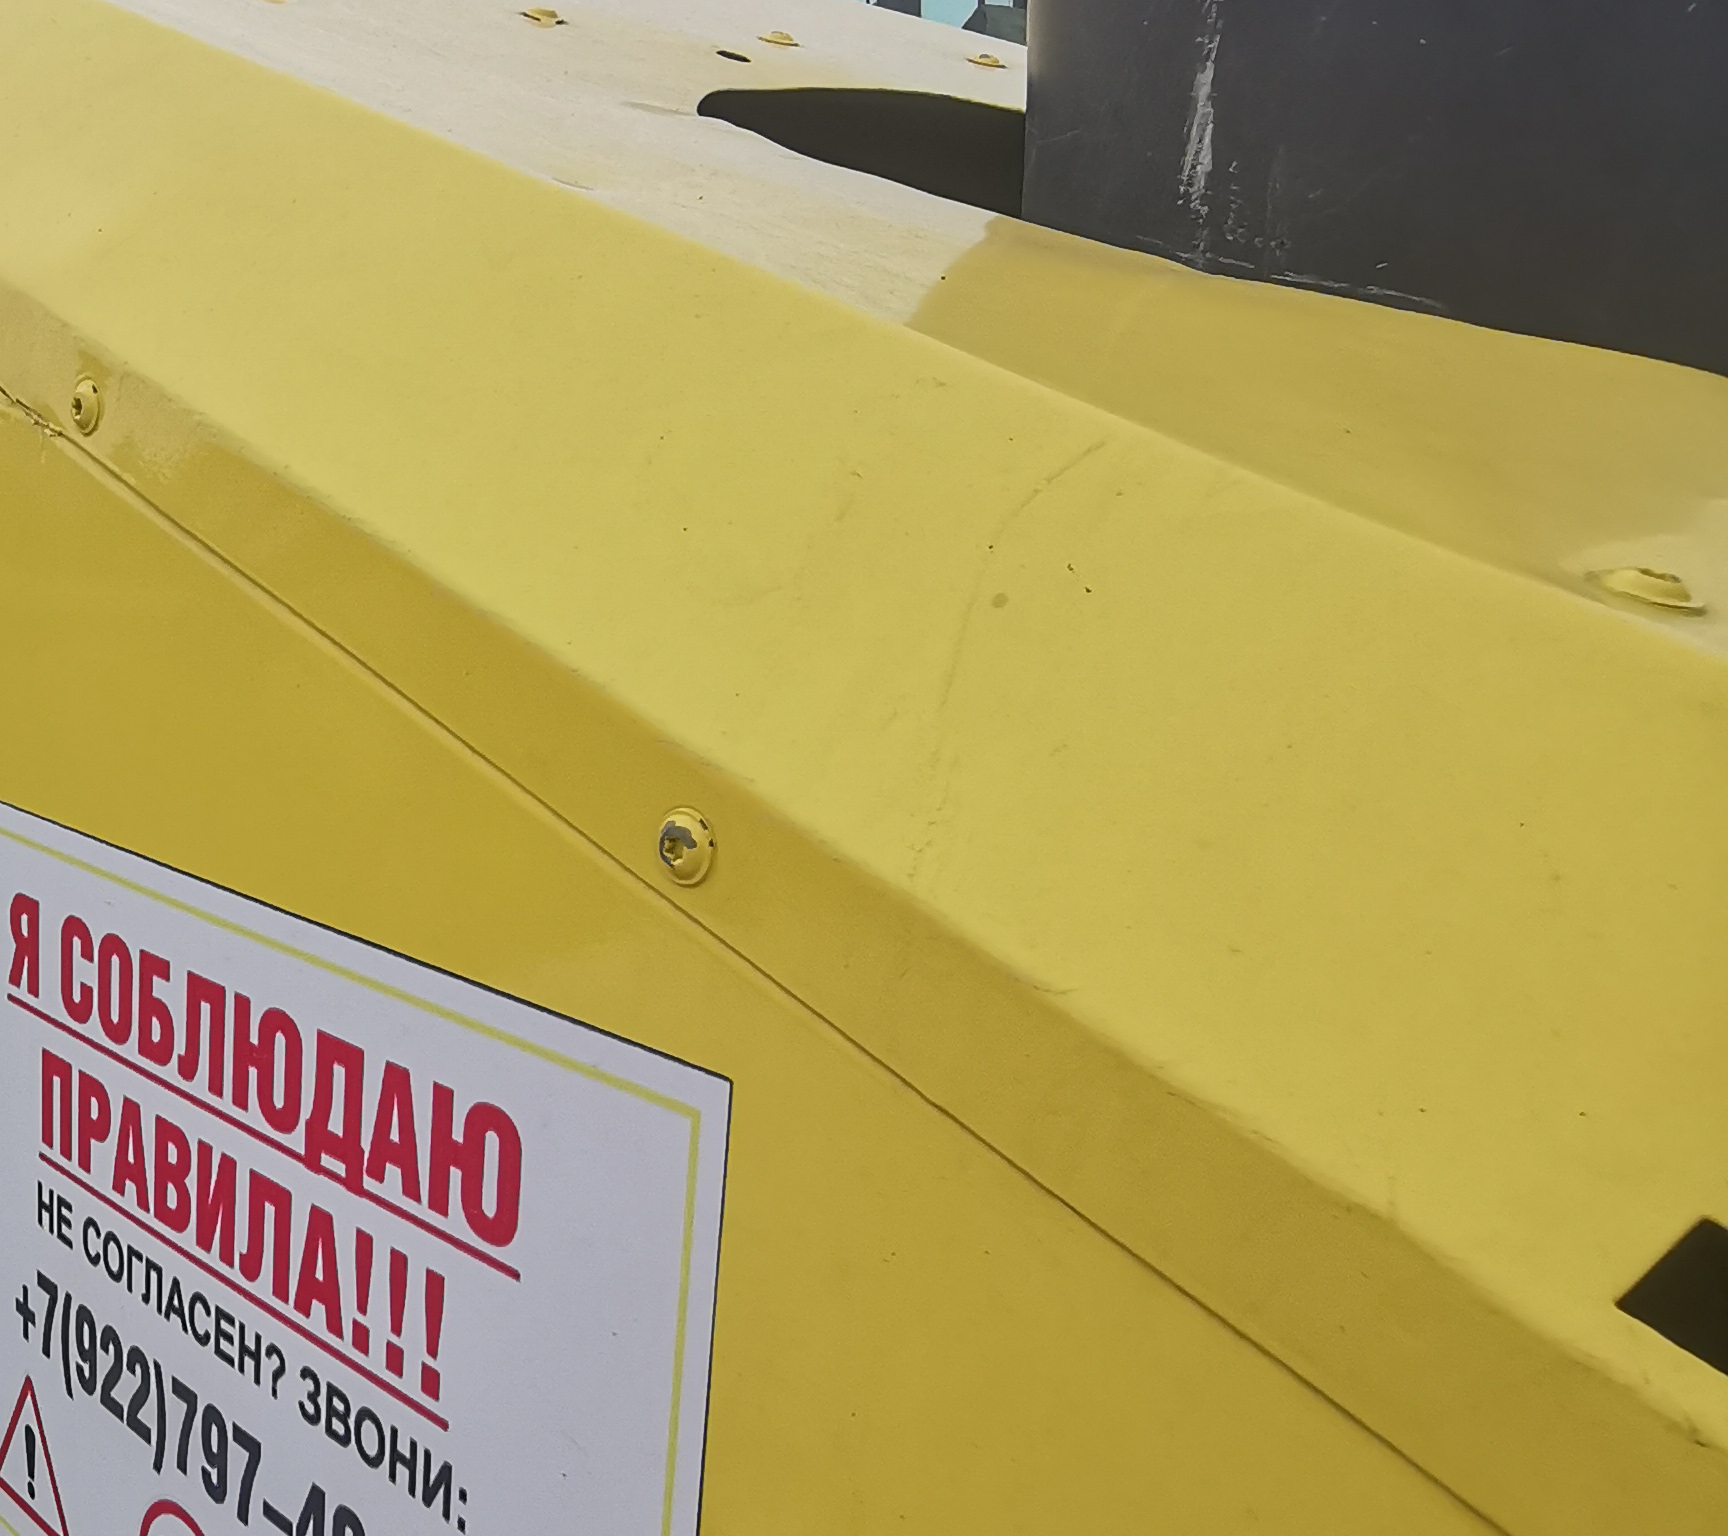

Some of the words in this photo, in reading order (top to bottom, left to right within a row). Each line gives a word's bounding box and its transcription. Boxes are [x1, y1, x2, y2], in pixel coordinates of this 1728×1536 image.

[8, 893, 41, 998] Я
[60, 915, 523, 1249] СОБЛЮДАЮ
[40, 1048, 447, 1402] ПРАВИЛА!!!
[36, 1180, 75, 1252] НЕ
[82, 1215, 288, 1401] СОГЛАСЕН?
[297, 1364, 469, 1536] ЗВОНИ:
